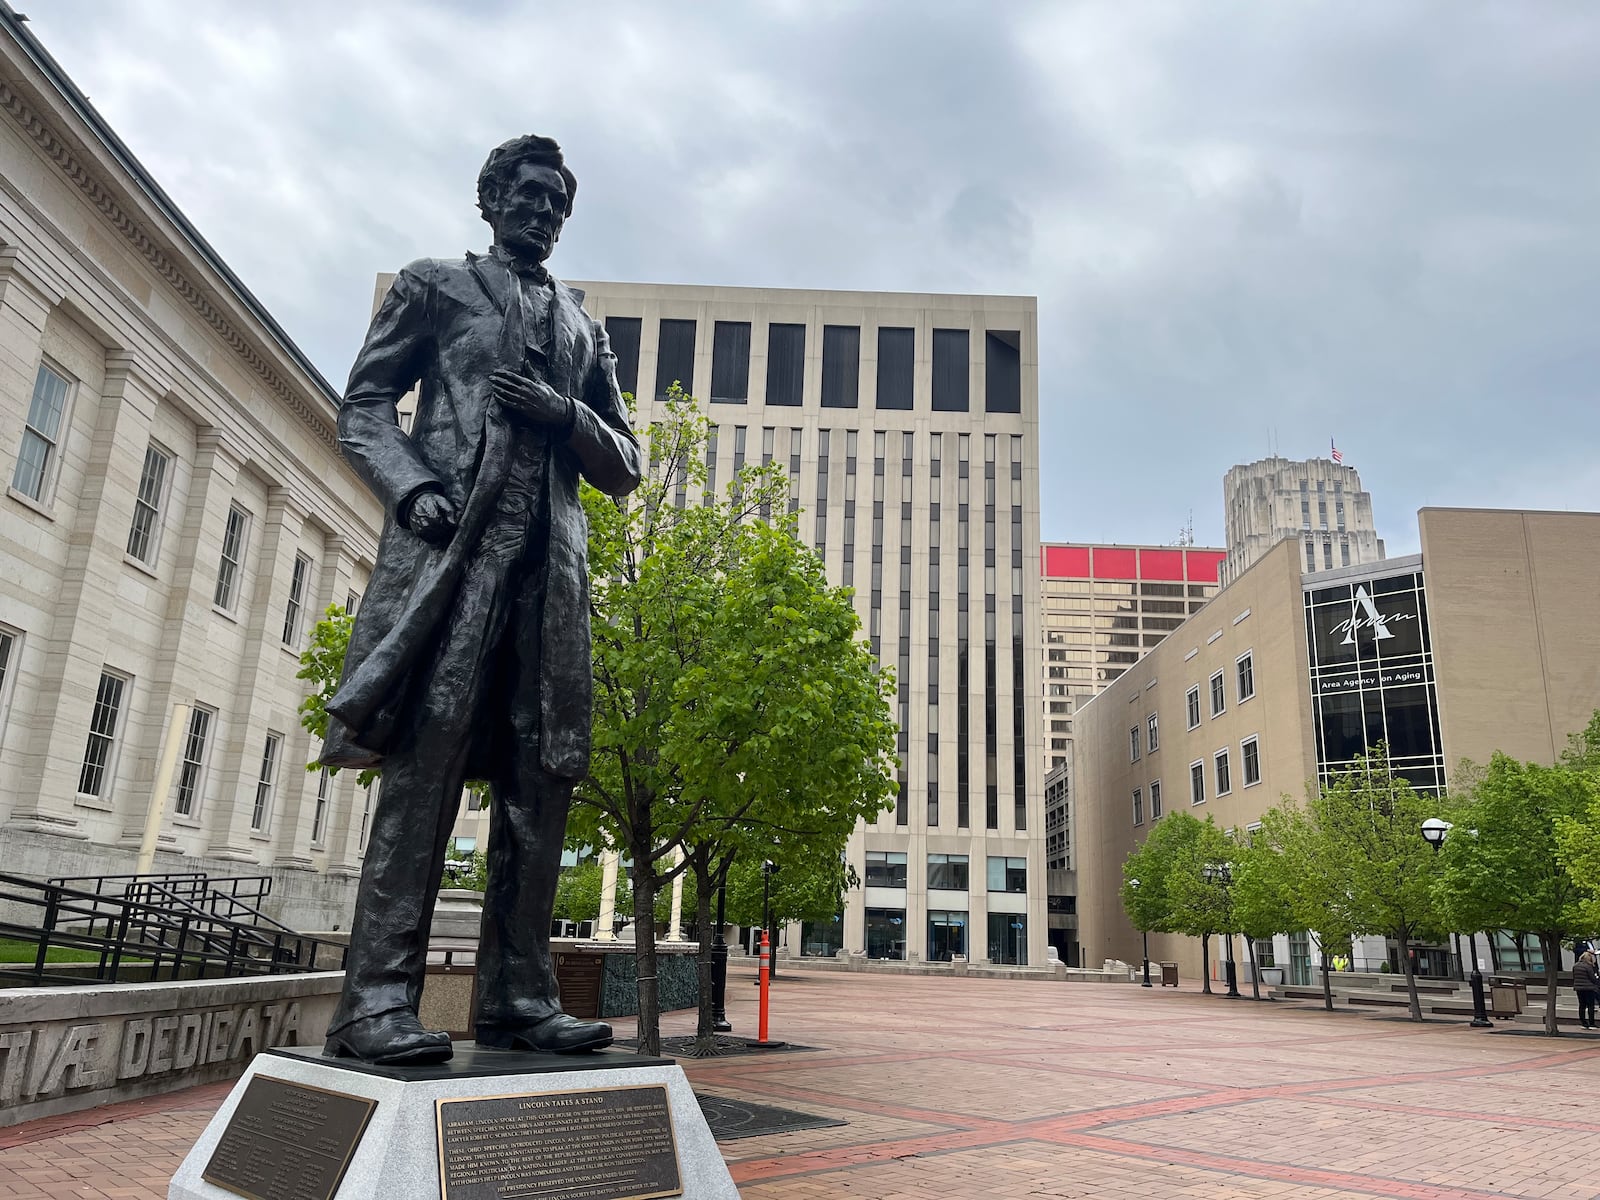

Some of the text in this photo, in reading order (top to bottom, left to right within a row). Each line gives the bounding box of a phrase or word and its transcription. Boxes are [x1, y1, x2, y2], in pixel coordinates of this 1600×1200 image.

[1321, 671, 1421, 689] Area Agency on Aging
[116, 1002, 299, 1080] DEDICATA
